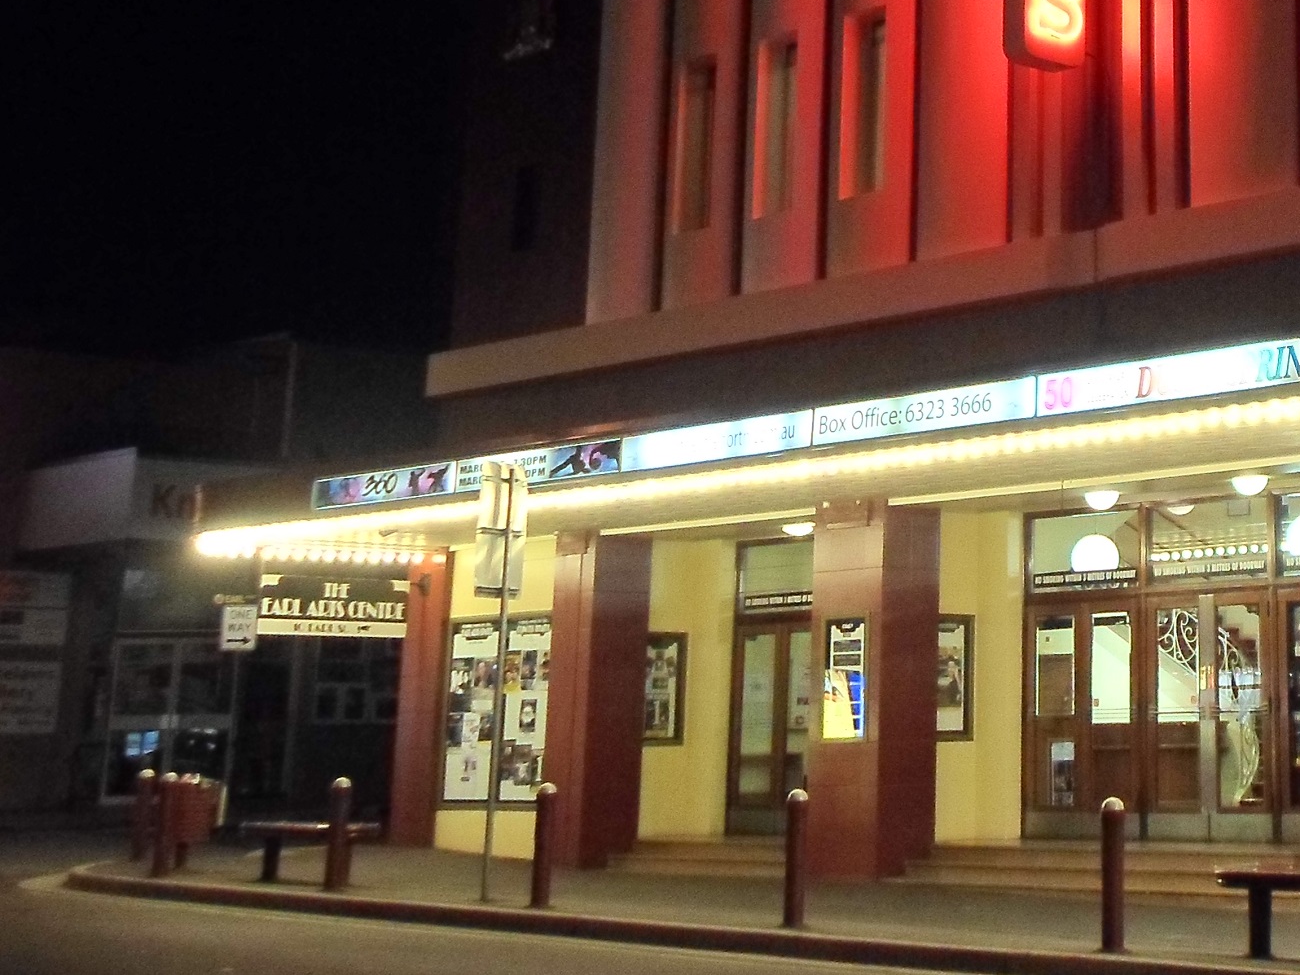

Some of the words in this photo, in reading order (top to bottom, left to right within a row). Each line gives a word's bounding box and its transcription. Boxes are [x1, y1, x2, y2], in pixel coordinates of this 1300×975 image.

[1044, 377, 1073, 410] 50
[818, 415, 847, 435] Box
[851, 407, 902, 430] Office:
[905, 399, 945, 423] 6323
[950, 393, 992, 417] 3666
[362, 472, 398, 497] 360
[324, 582, 350, 598] THE
[231, 609, 252, 620] ONE
[261, 597, 303, 616] EARL
[306, 599, 346, 618] ARTS
[348, 601, 406, 620] CENTRE
[228, 622, 251, 633] WAY
